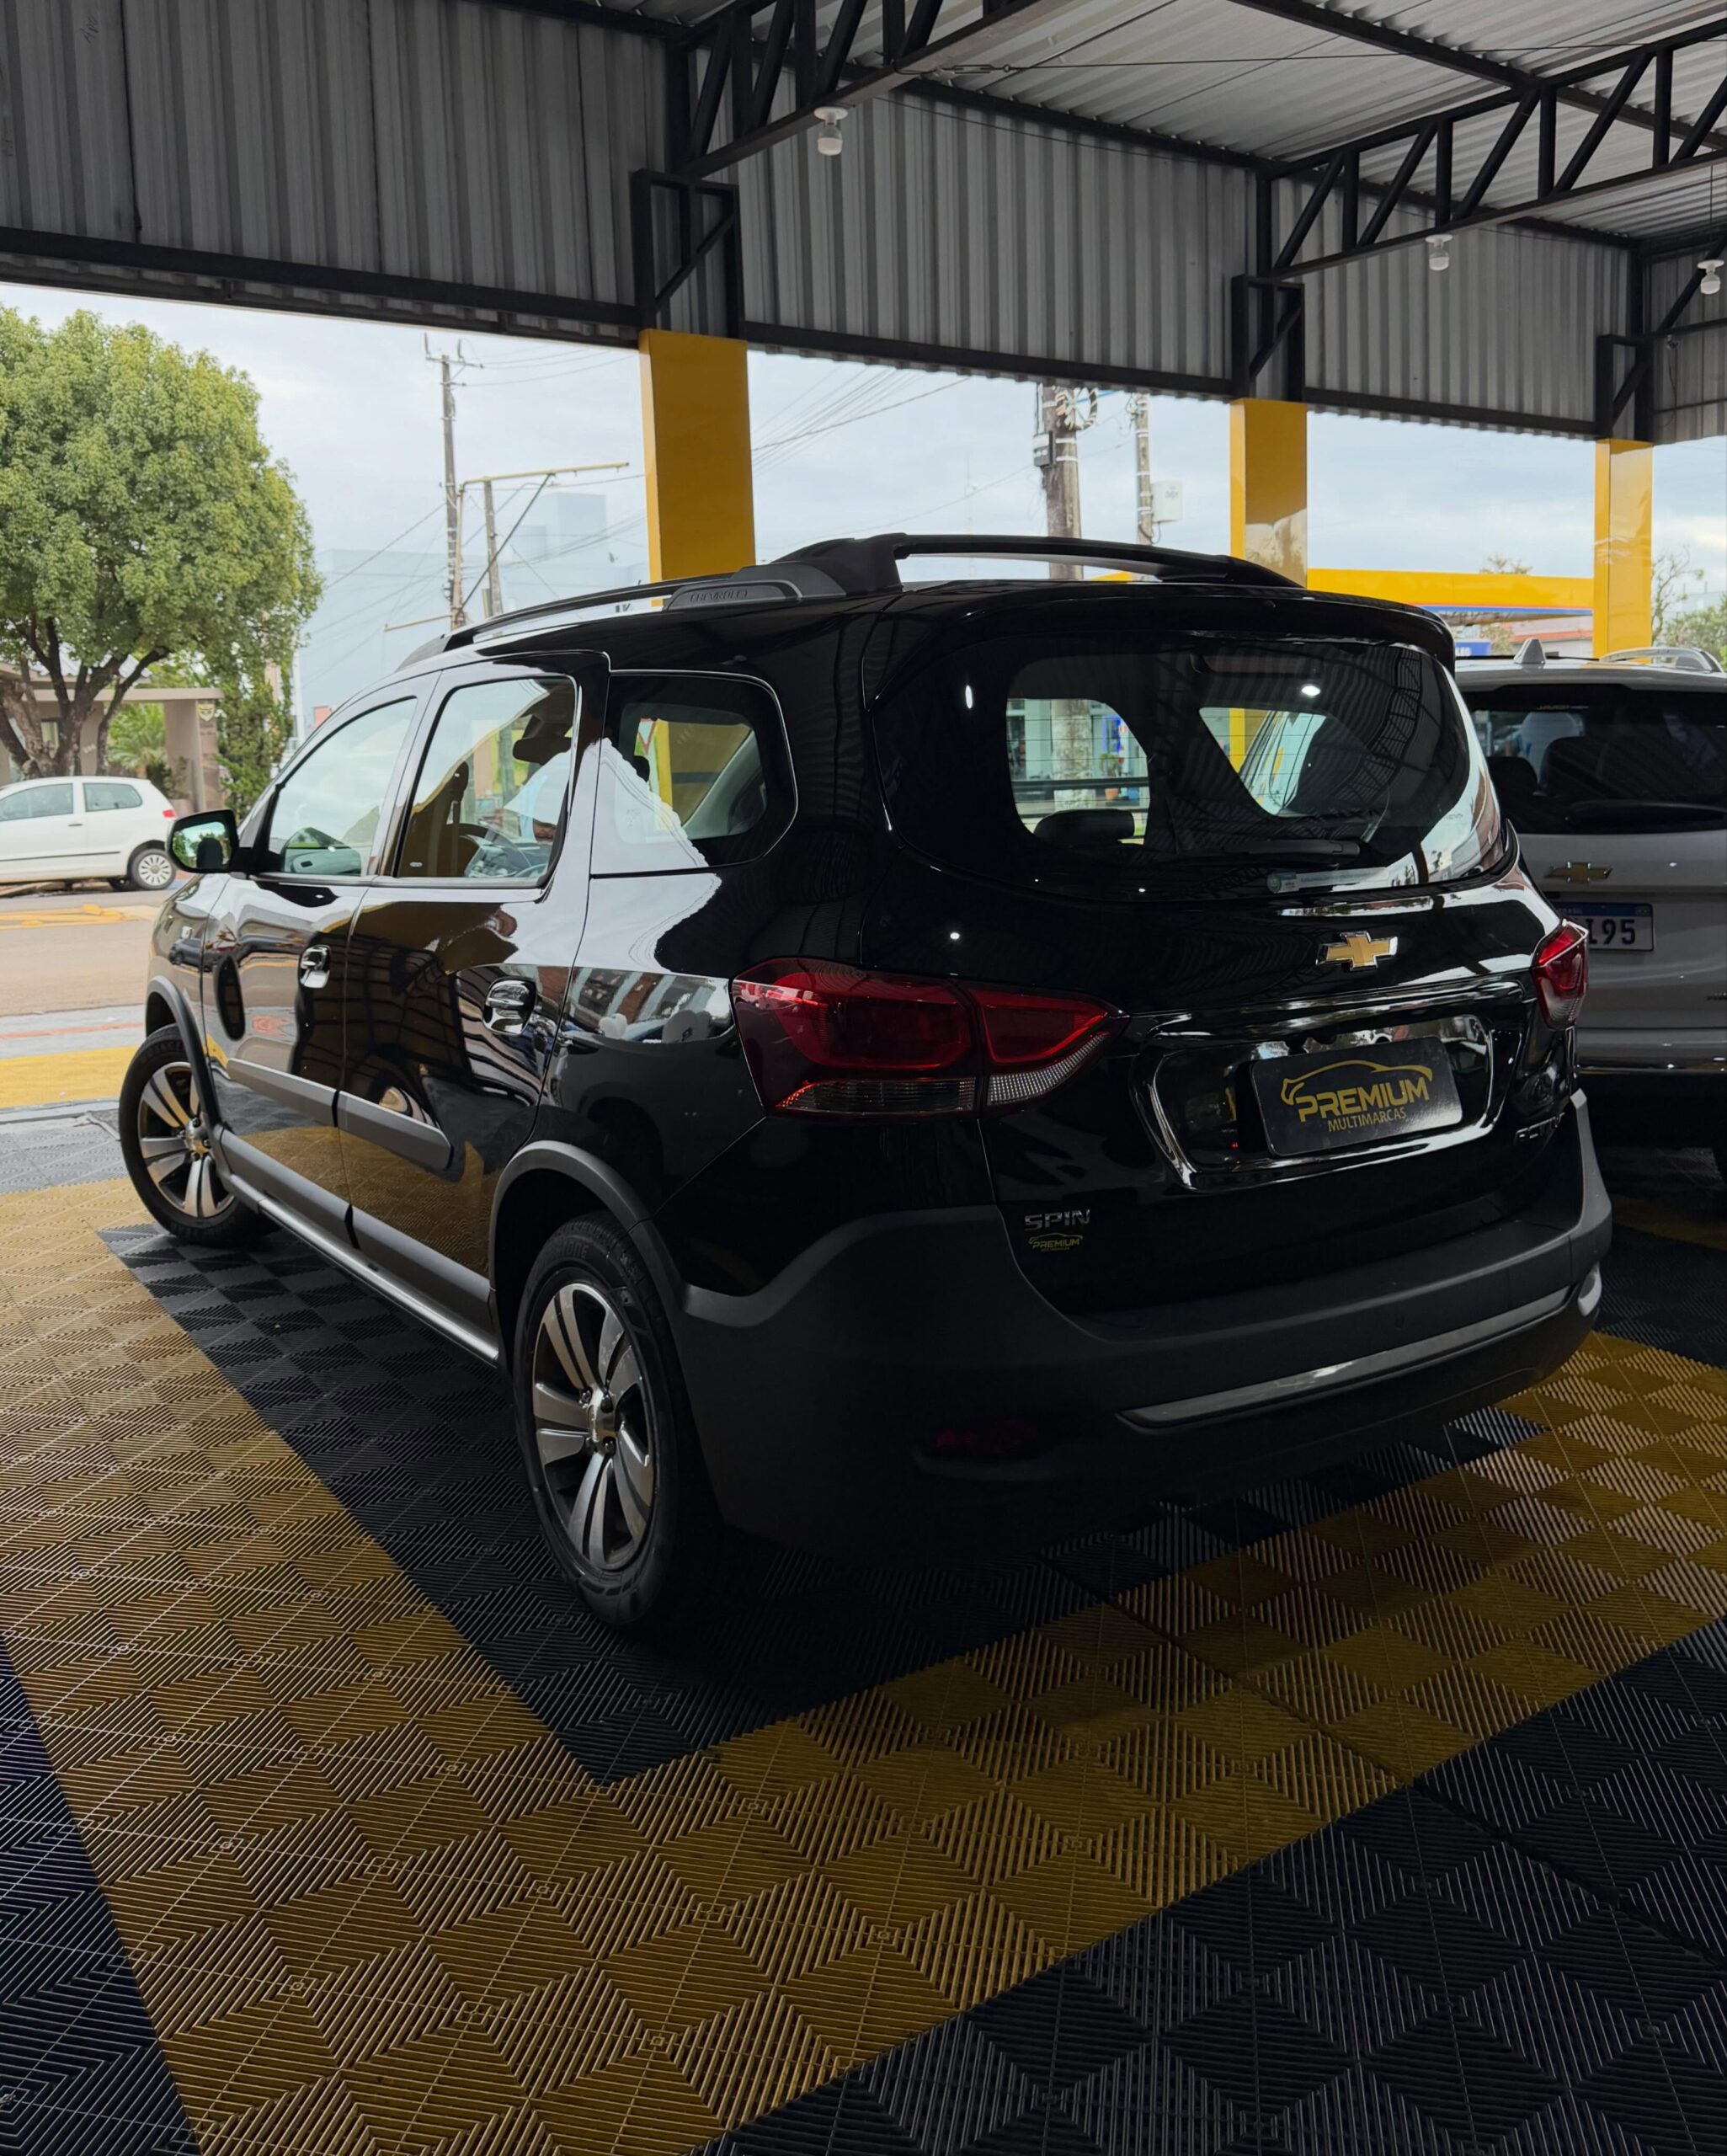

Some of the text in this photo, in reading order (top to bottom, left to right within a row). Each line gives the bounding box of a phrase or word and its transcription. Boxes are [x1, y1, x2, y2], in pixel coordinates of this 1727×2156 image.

[690, 589, 749, 603] CHEVROLET
[1295, 1077, 1431, 1123] PREMIUM
[1328, 1107, 1407, 1133] MULTIMARCAS
[1024, 1209, 1091, 1232] SPIN
[1032, 1238, 1081, 1250] PREMIUM
